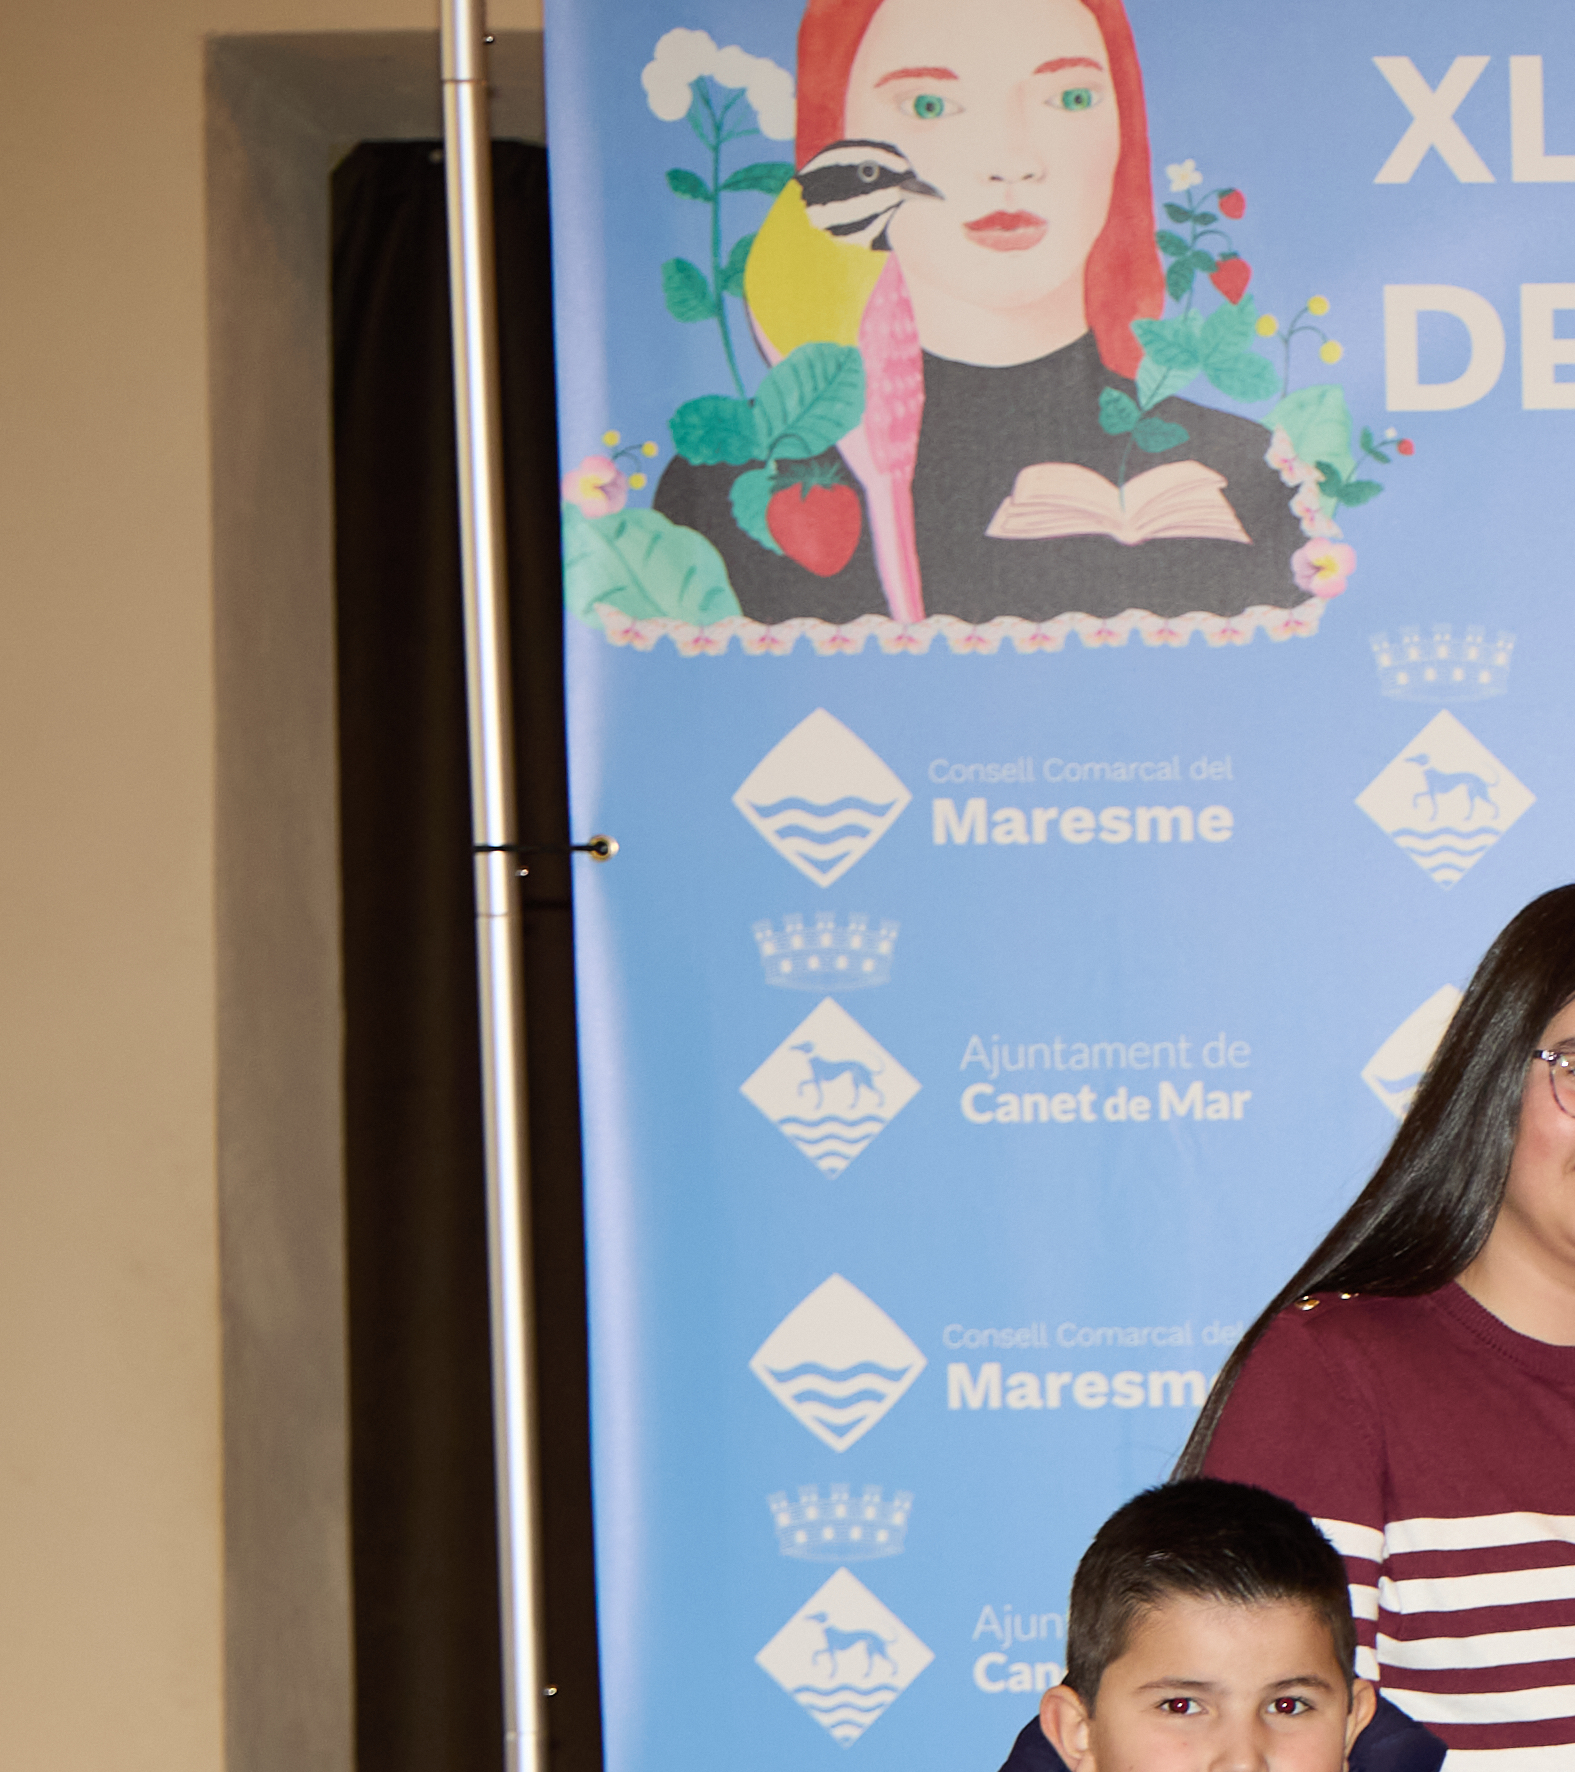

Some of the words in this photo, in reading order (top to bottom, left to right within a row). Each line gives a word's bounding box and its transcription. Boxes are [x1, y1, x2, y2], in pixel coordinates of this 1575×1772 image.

[928, 757, 1036, 783] Consell
[1043, 755, 1182, 782] Comarcal
[1190, 756, 1233, 781] del
[933, 798, 1234, 844] Maresme
[960, 1034, 1192, 1079] Ajuntament
[1202, 1032, 1251, 1068] de
[961, 1083, 1096, 1123] Canet
[1104, 1087, 1151, 1121] de
[1159, 1081, 1251, 1120] Mar
[943, 1321, 1050, 1349] Consell
[1056, 1319, 1195, 1348] Comarcal
